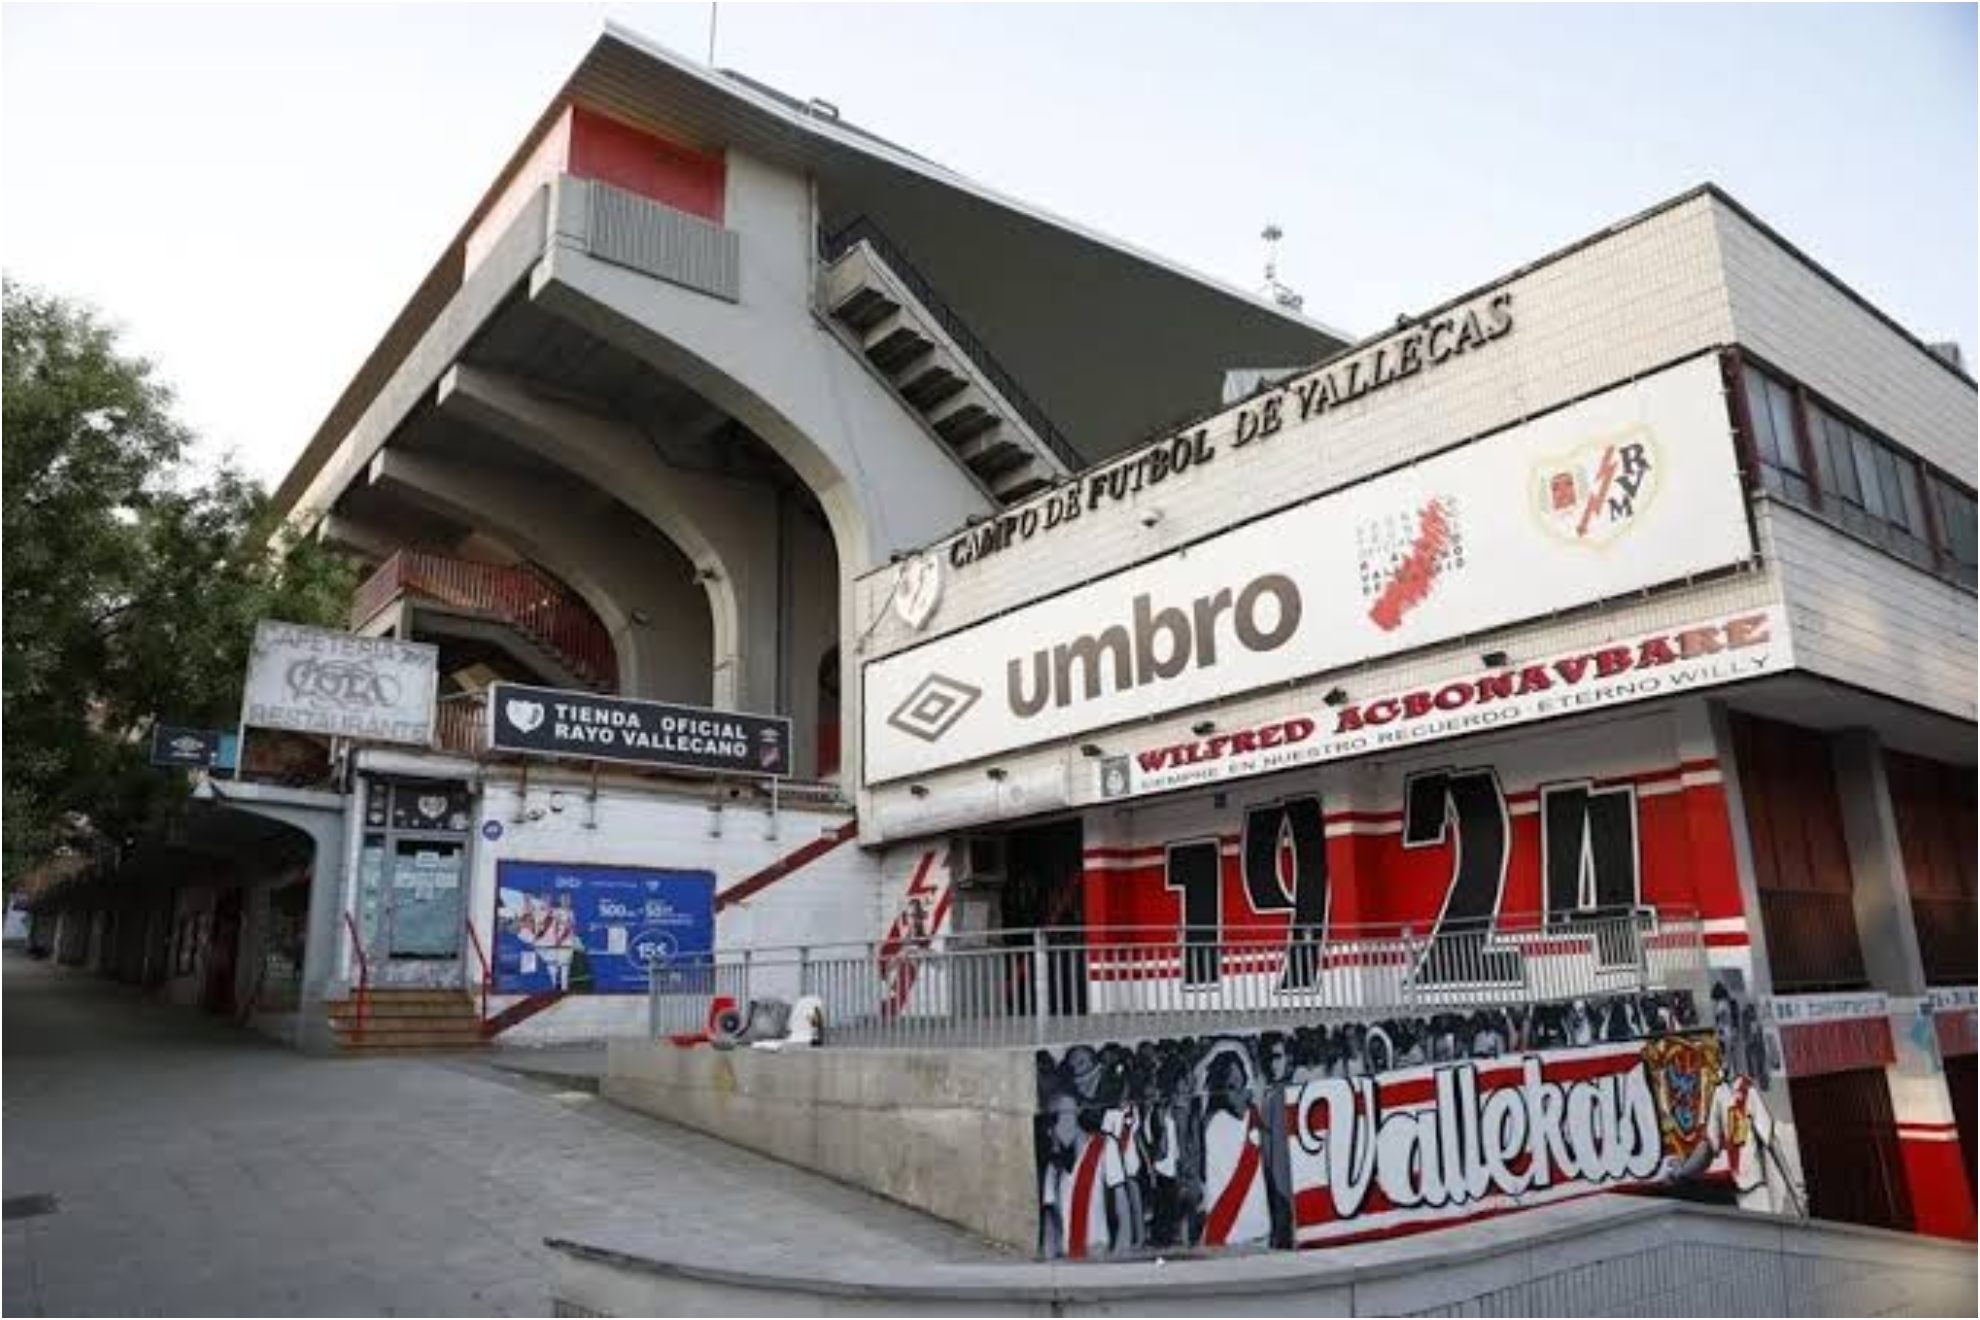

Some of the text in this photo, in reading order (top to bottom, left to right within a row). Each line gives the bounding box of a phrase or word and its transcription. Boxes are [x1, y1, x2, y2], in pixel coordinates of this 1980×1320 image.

[949, 510, 1037, 569] CAMPO
[1042, 489, 1082, 534] DE
[1231, 399, 1285, 449] DE
[1297, 295, 1513, 420] VALLECAS
[1006, 574, 1302, 722] umbro
[1228, 759, 1254, 773] EN
[1263, 738, 1368, 767] NUESTRO
[1377, 706, 1520, 744] RECUERDO
[1538, 679, 1661, 714] ETERNO
[1668, 655, 1770, 687] WILLY
[554, 703, 748, 740] TIENDA OFICIAL
[554, 725, 748, 758] RAYO VALLECANO
[1136, 717, 1316, 773] WILFRED
[1165, 765, 1657, 996] 1924
[1298, 1056, 1664, 1219] Vallekas
